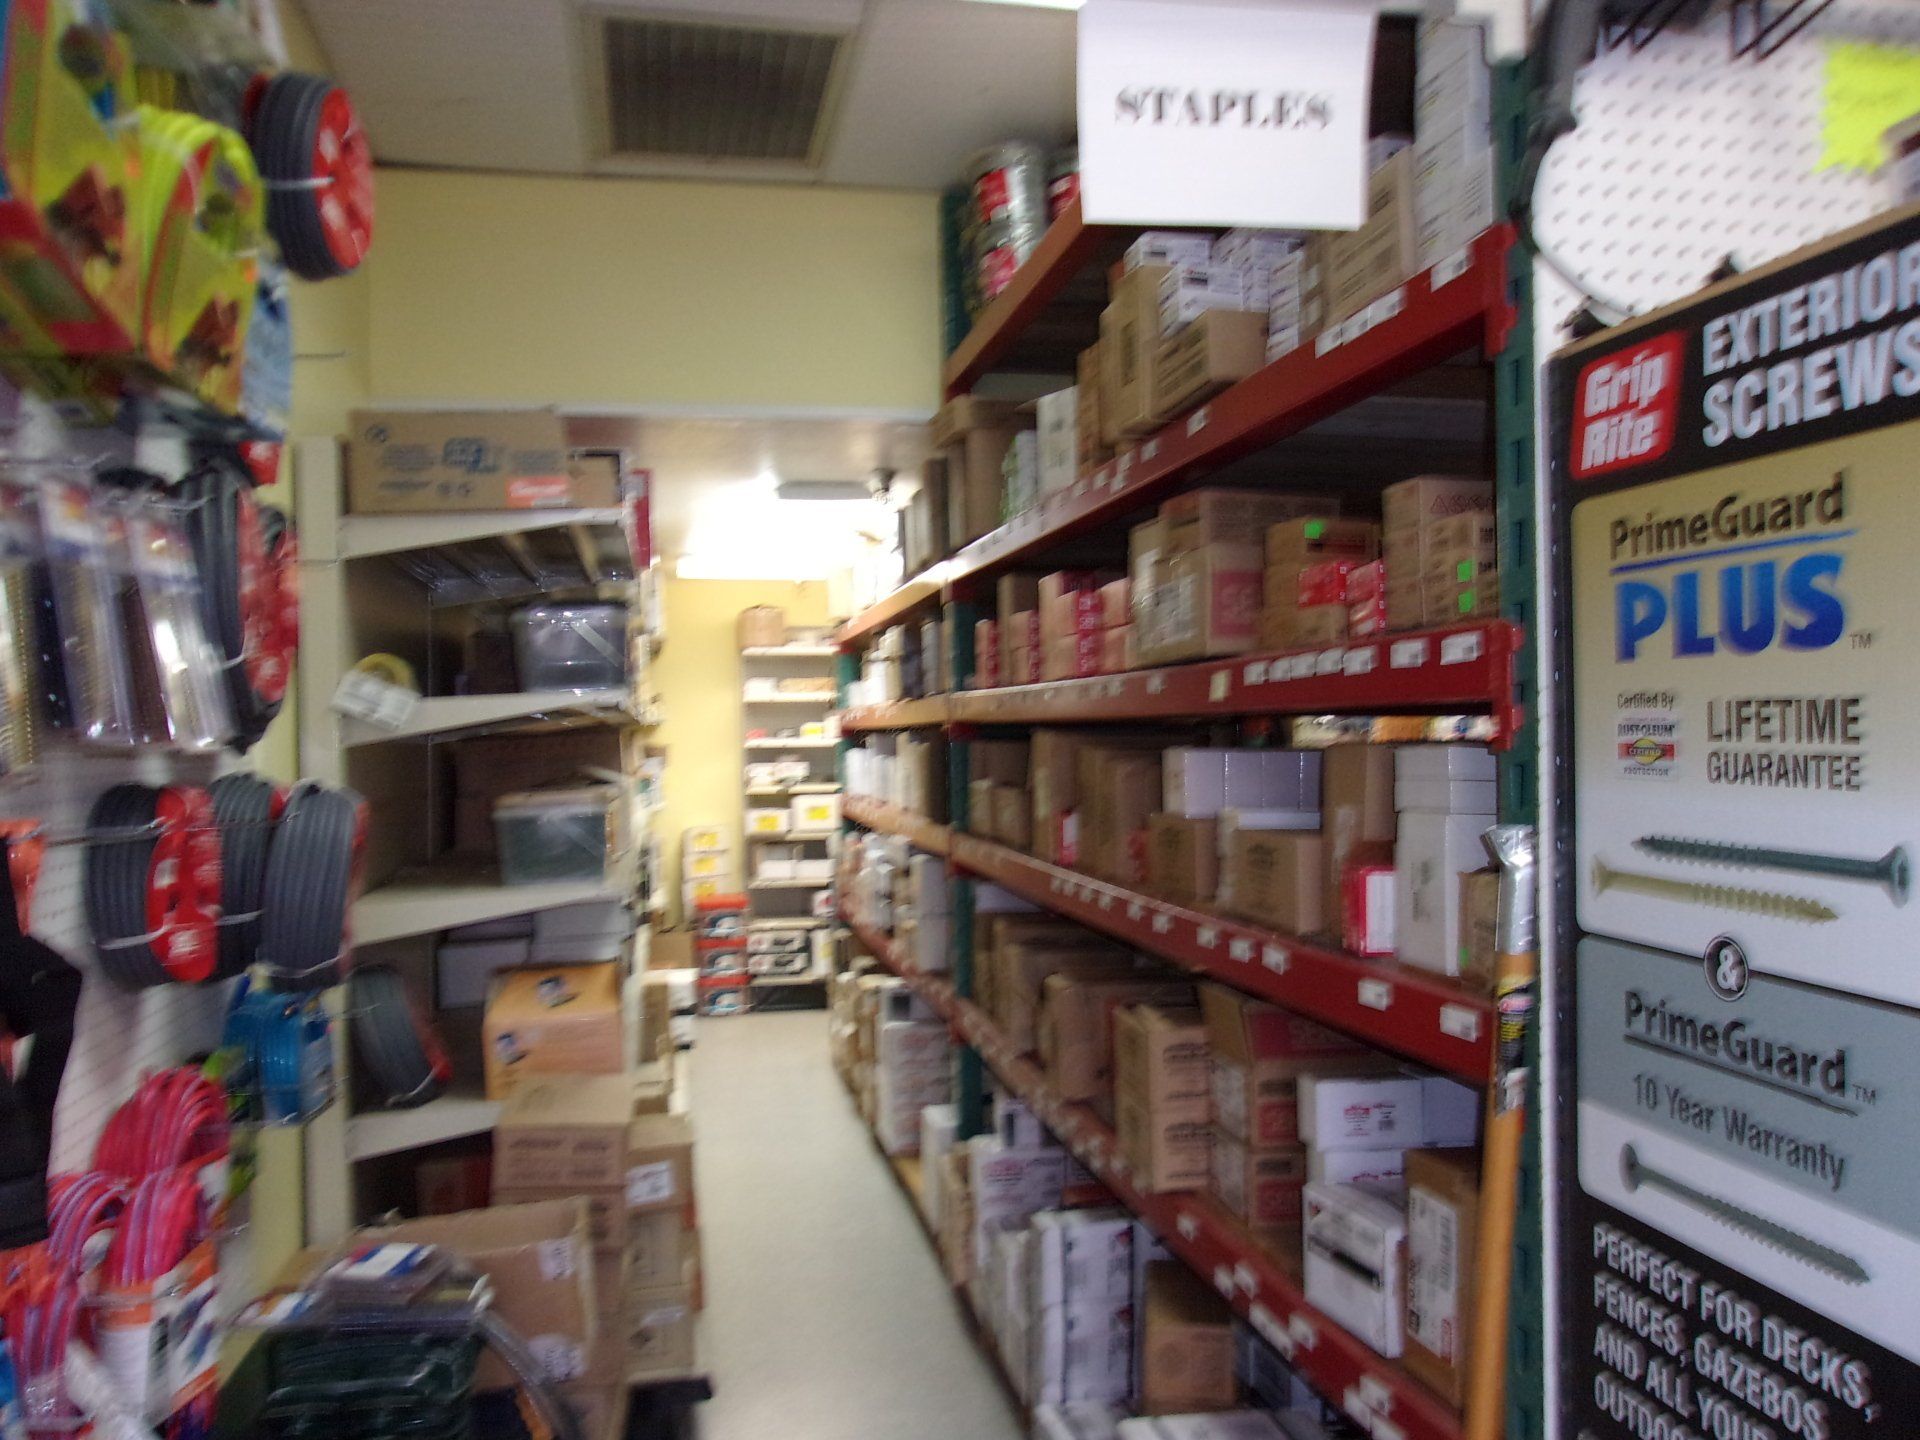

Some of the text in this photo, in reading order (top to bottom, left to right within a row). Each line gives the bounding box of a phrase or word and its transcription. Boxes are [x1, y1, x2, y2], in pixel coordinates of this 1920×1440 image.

[1114, 85, 1333, 129] STAPLES
[1702, 240, 1920, 377] EXTERIOR
[1583, 350, 1668, 417] Grip
[1702, 317, 1920, 448] SCREWS
[1581, 409, 1662, 471] Rite
[1610, 471, 1844, 560] PrimeGuard
[1614, 552, 1845, 664] PLUS
[1617, 691, 1674, 711] Certified By
[1706, 698, 1861, 745] LIFETIME
[1706, 751, 1862, 792] GUARANTEE
[1623, 989, 1846, 1098] PrimeGuard
[1633, 1073, 1845, 1193] 10 Year Warranty
[1592, 1222, 1879, 1424] PERFECT FOR DECKS,
[1592, 1271, 1828, 1440] FENCES, GAZEBOS
[1593, 1324, 1643, 1382] AND
[1645, 1356, 1696, 1419] ALL
